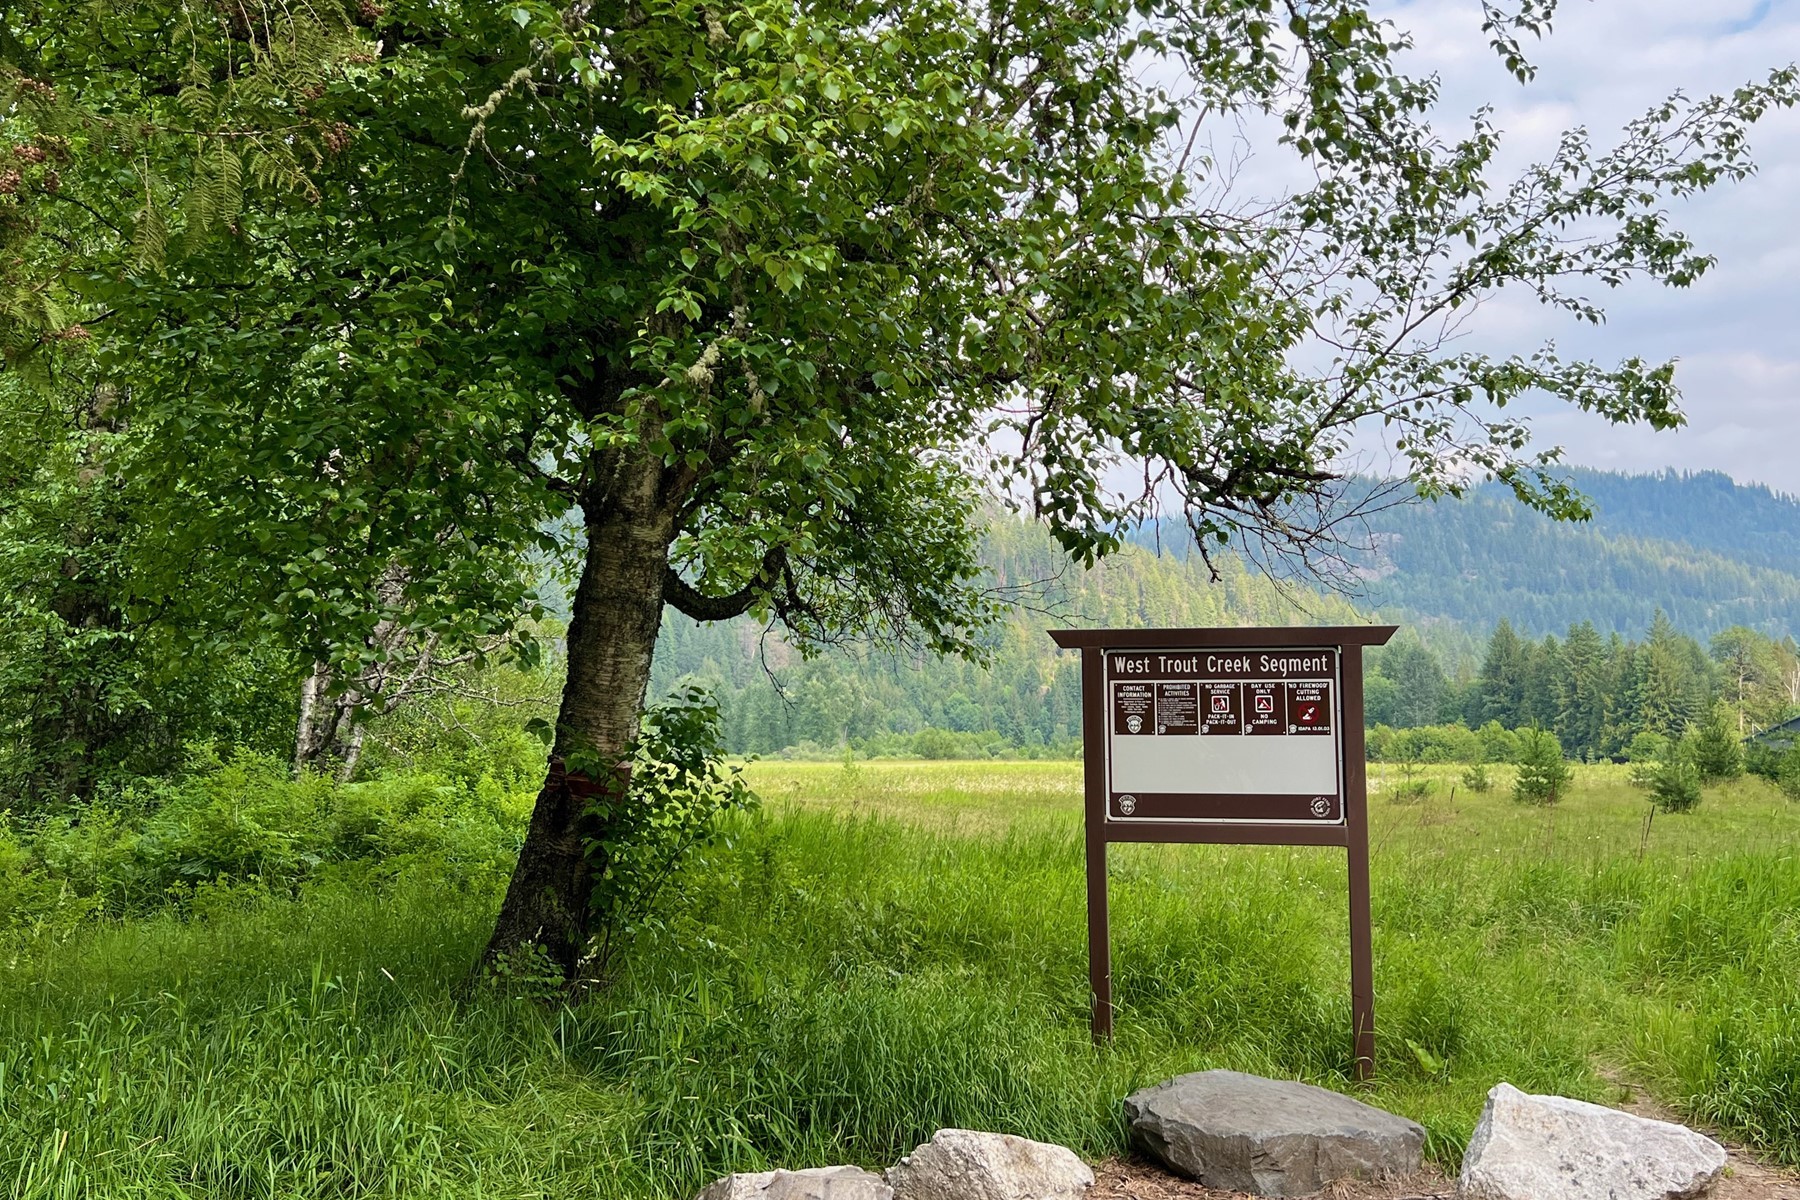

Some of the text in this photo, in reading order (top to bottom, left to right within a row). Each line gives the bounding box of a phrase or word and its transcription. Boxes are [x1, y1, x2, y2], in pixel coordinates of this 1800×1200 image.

[1114, 655, 1328, 677] West Trout Creek Segment
